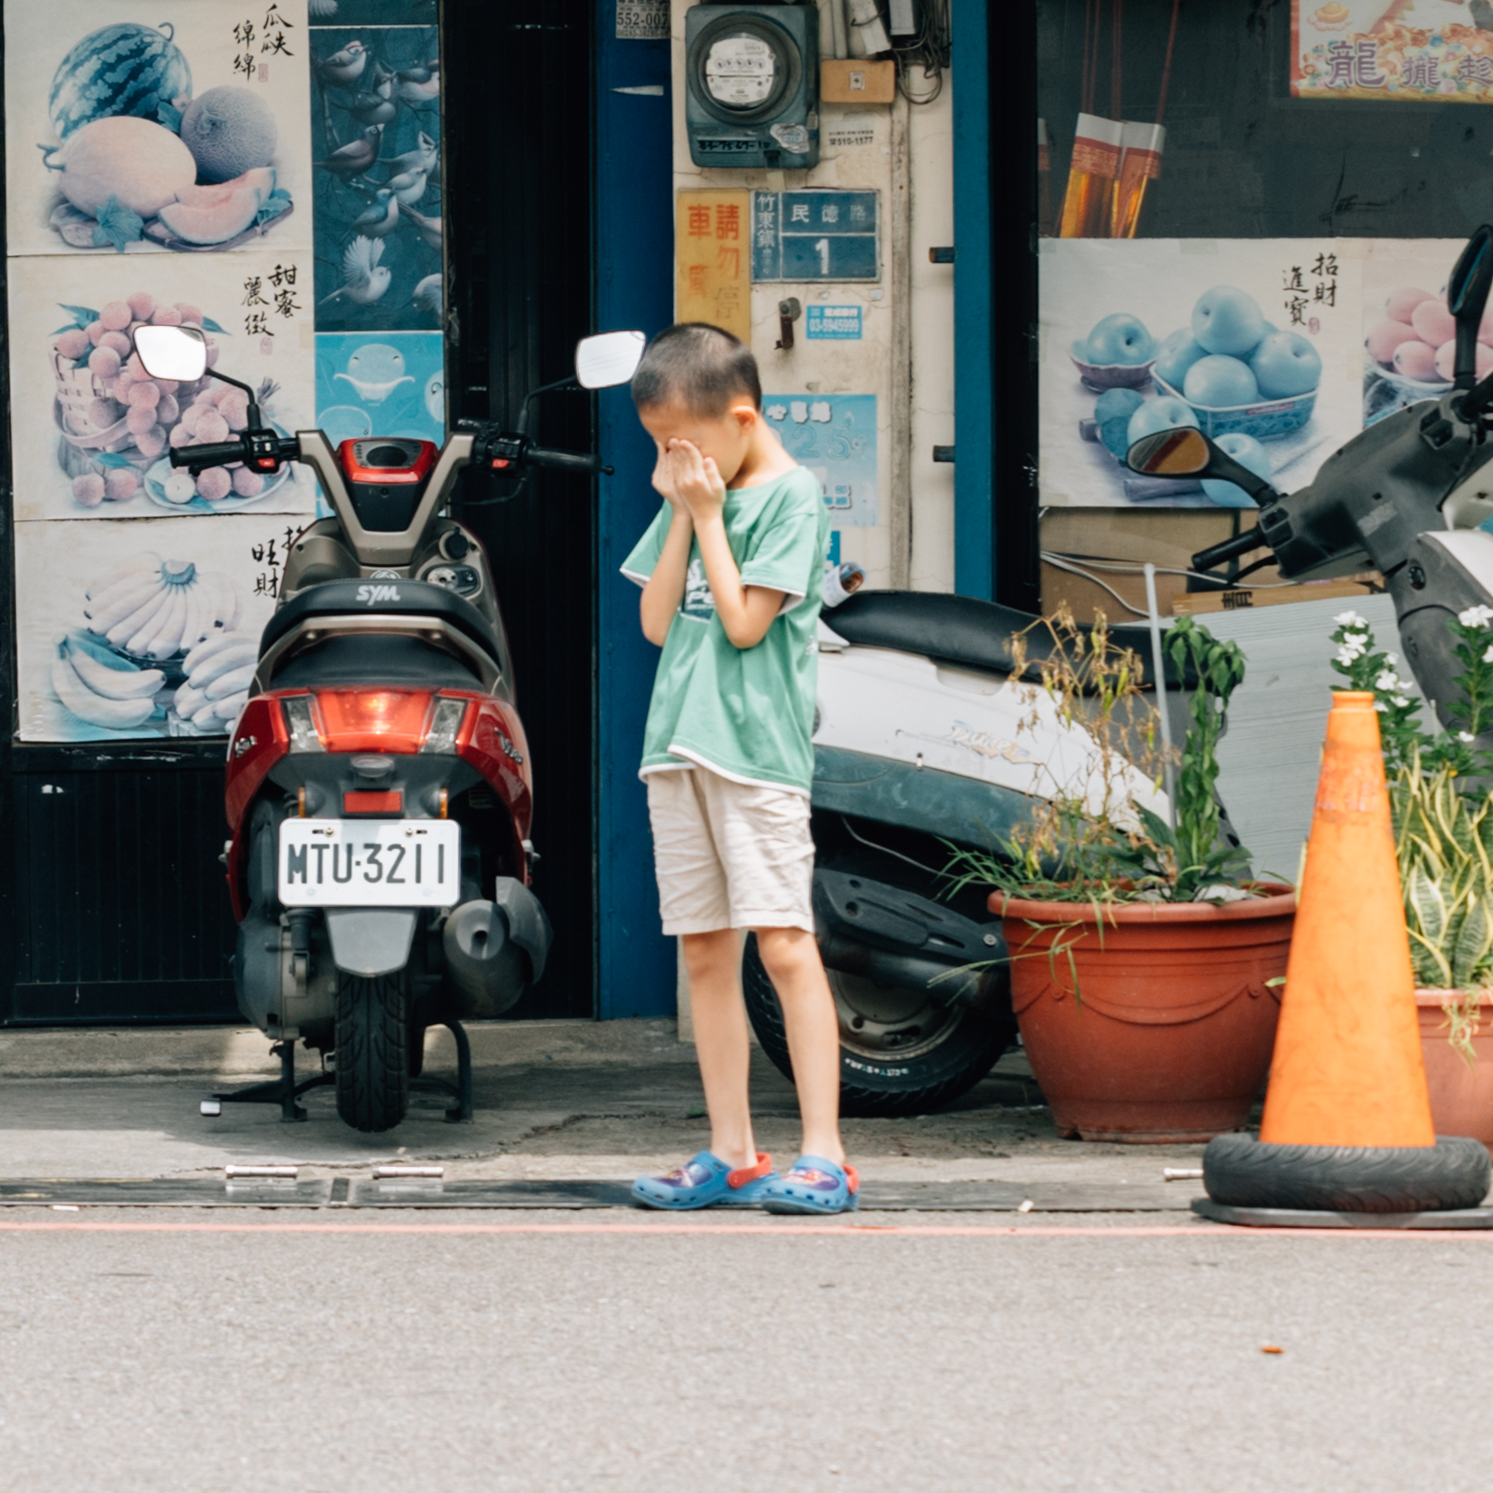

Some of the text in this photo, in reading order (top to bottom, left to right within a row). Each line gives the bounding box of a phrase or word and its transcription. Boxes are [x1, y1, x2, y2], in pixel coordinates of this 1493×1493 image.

[232, 21, 257, 82] 綿綿
[756, 194, 776, 248] 竹東鎮
[790, 203, 867, 224] 民德路
[815, 238, 830, 275] 1
[1310, 252, 1339, 307] 招財
[267, 263, 302, 319] 甜蜜
[1281, 265, 1310, 327] 進寶
[251, 538, 280, 599] 旺財
[355, 584, 401, 606] SYM
